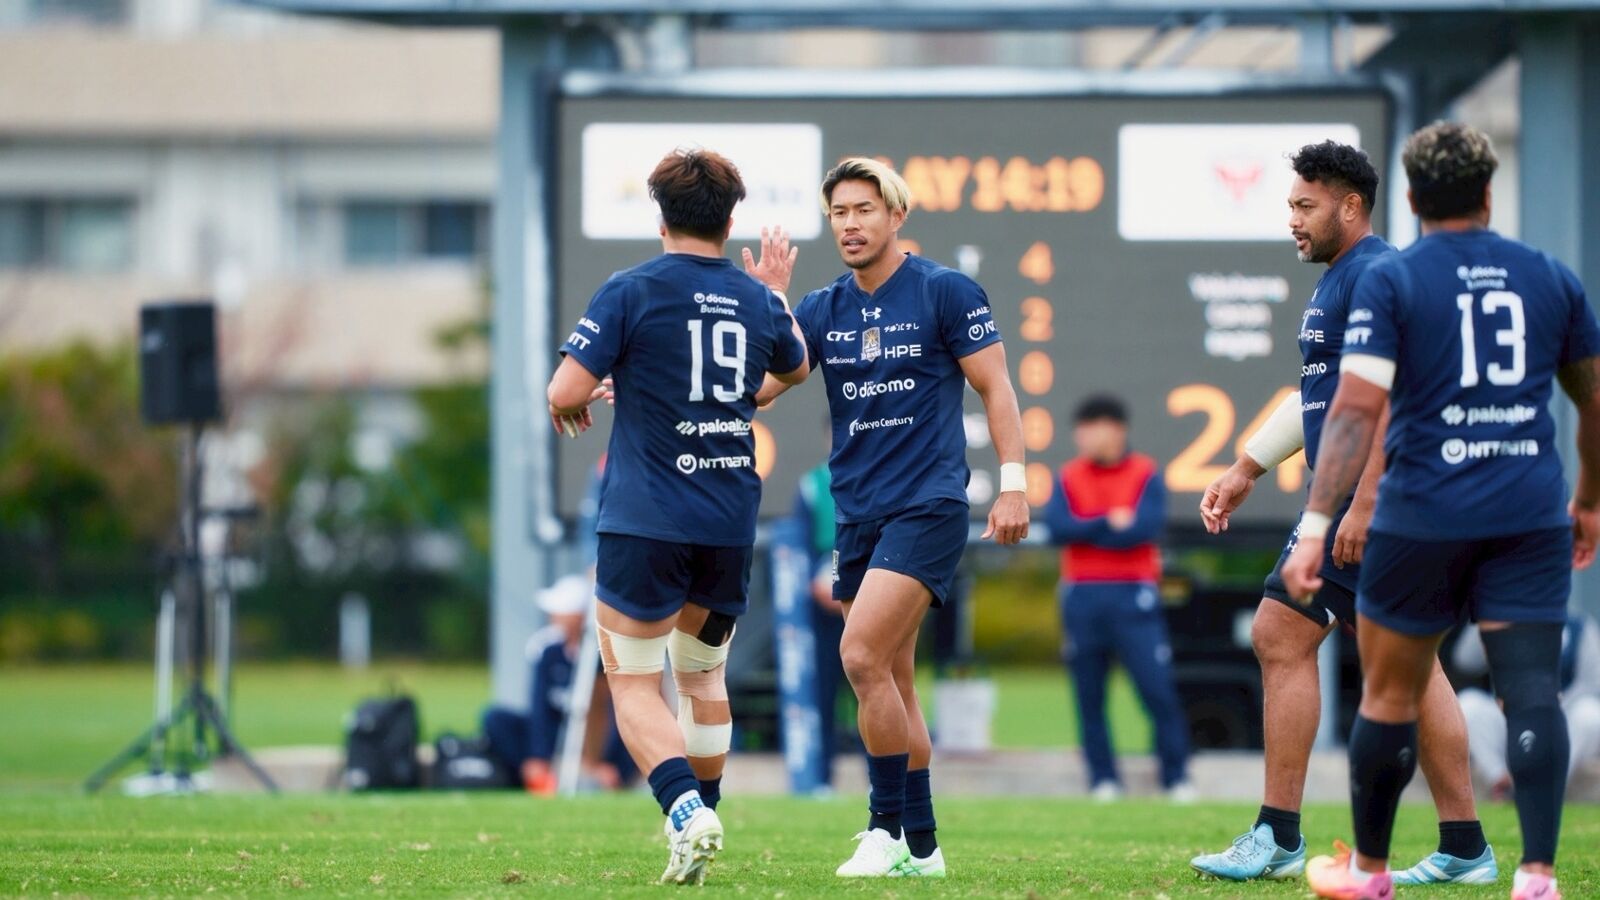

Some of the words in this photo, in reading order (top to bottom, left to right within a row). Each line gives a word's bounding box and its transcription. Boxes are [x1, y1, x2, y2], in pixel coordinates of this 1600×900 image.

[700, 303, 736, 316] Business
[826, 330, 857, 342] CTC
[1456, 291, 1526, 388] 13
[688, 319, 747, 402] 19
[884, 344, 922, 360] HPE
[859, 377, 916, 399] docomo
[698, 418, 752, 437] paloalto
[855, 420, 880, 432] Tokyo
[880, 416, 914, 427] Century
